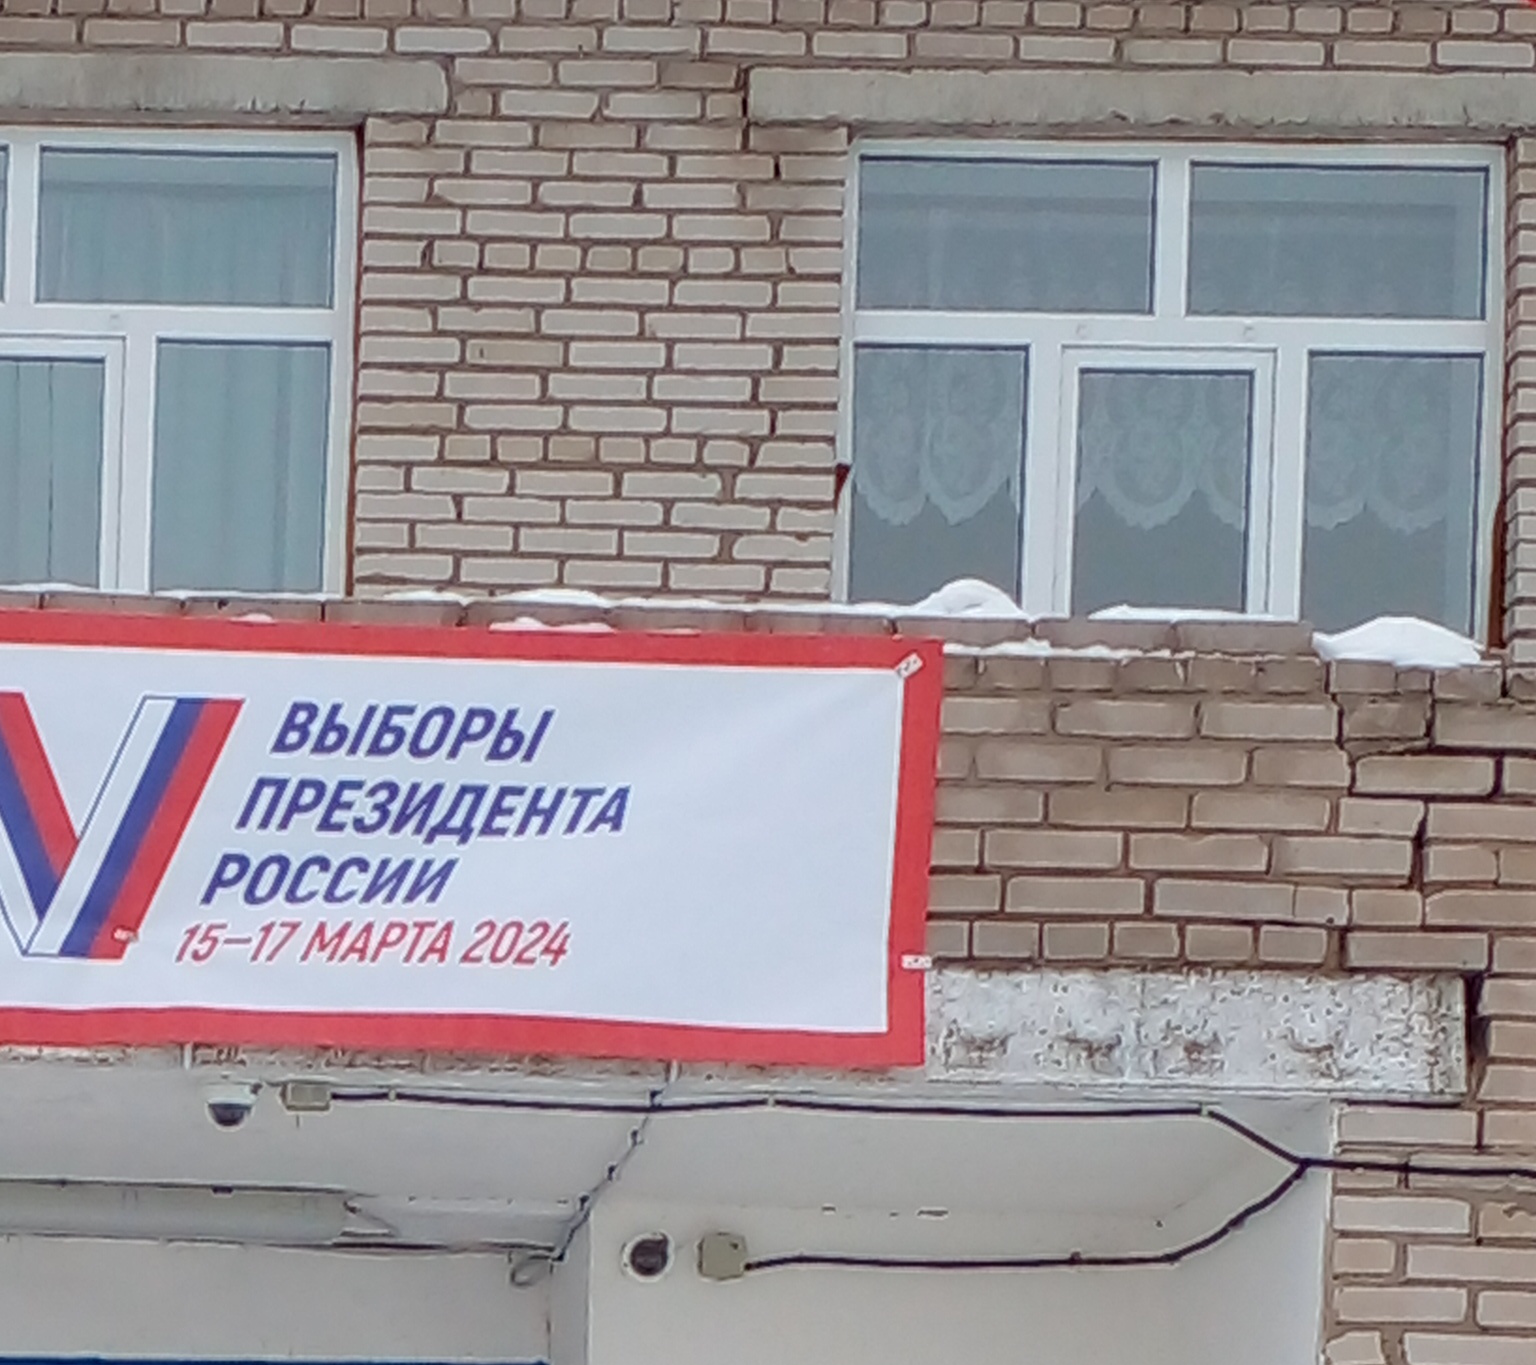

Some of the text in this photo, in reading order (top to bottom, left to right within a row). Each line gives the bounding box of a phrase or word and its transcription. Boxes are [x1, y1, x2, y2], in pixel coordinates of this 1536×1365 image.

[271, 702, 553, 763] ВЫБОРЫ
[236, 777, 630, 845] ПРЕЗИДЕНТА
[201, 851, 459, 907] РОССИИ
[303, 922, 454, 966] МАРТА
[462, 919, 571, 967] 2024
